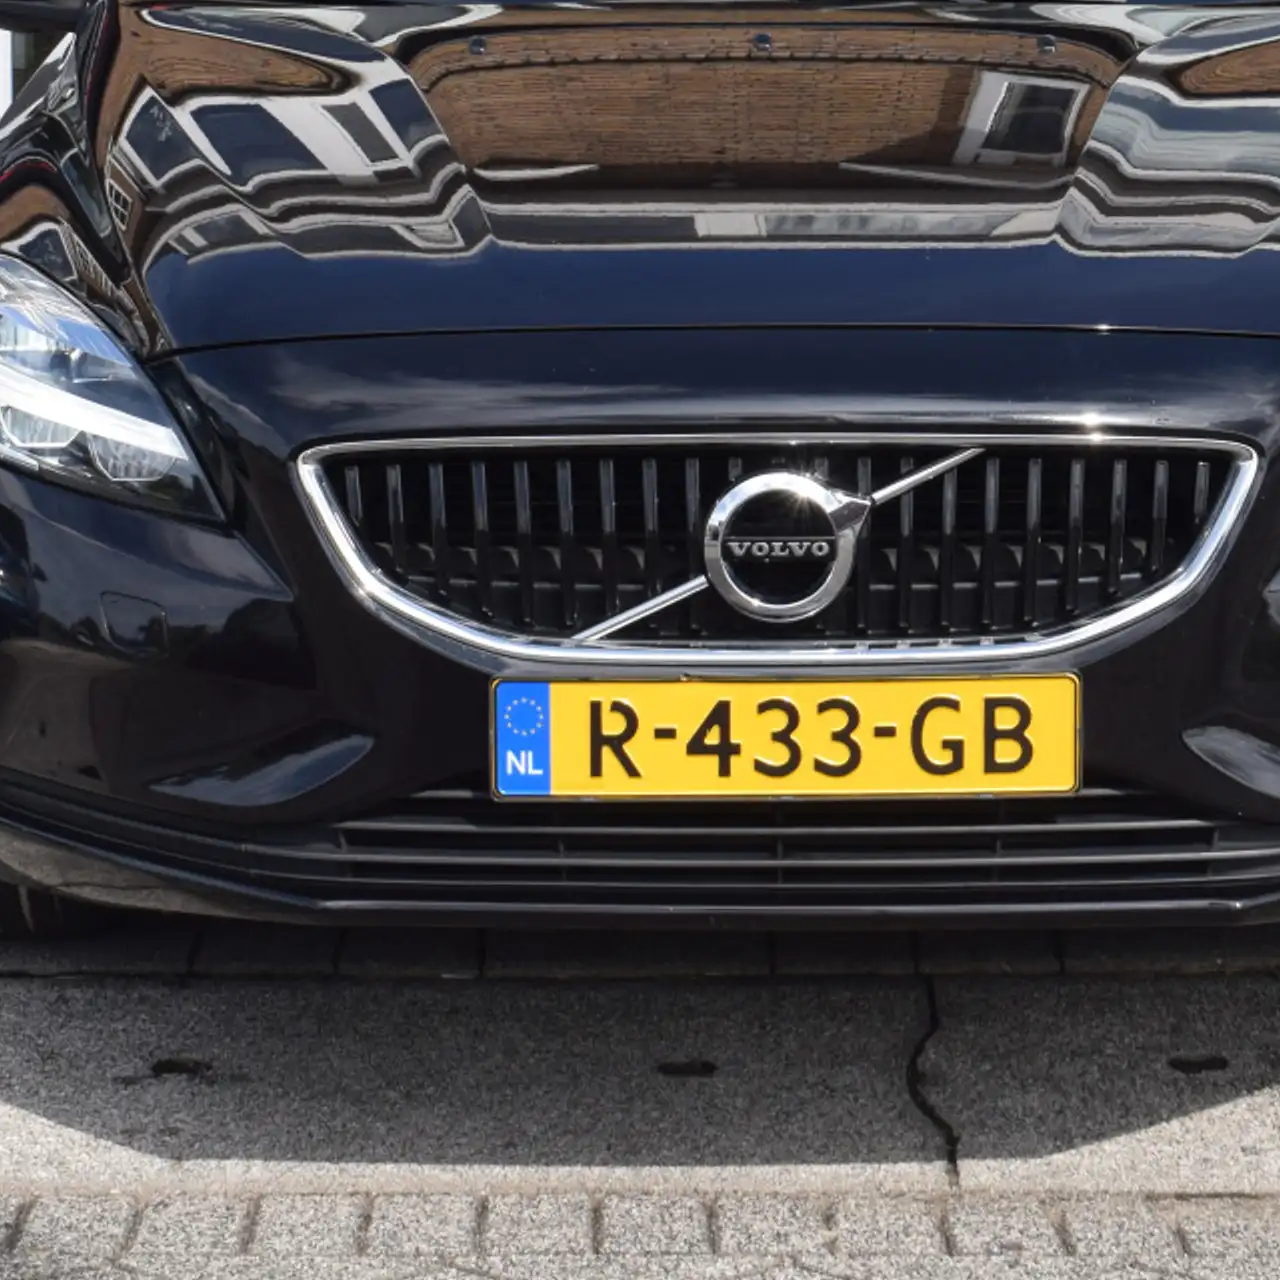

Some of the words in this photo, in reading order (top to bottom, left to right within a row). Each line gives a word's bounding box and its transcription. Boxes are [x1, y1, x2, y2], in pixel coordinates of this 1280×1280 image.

[727, 541, 830, 557] VOLVO
[506, 749, 544, 776] NL
[588, 695, 1034, 778] R-433-GB
